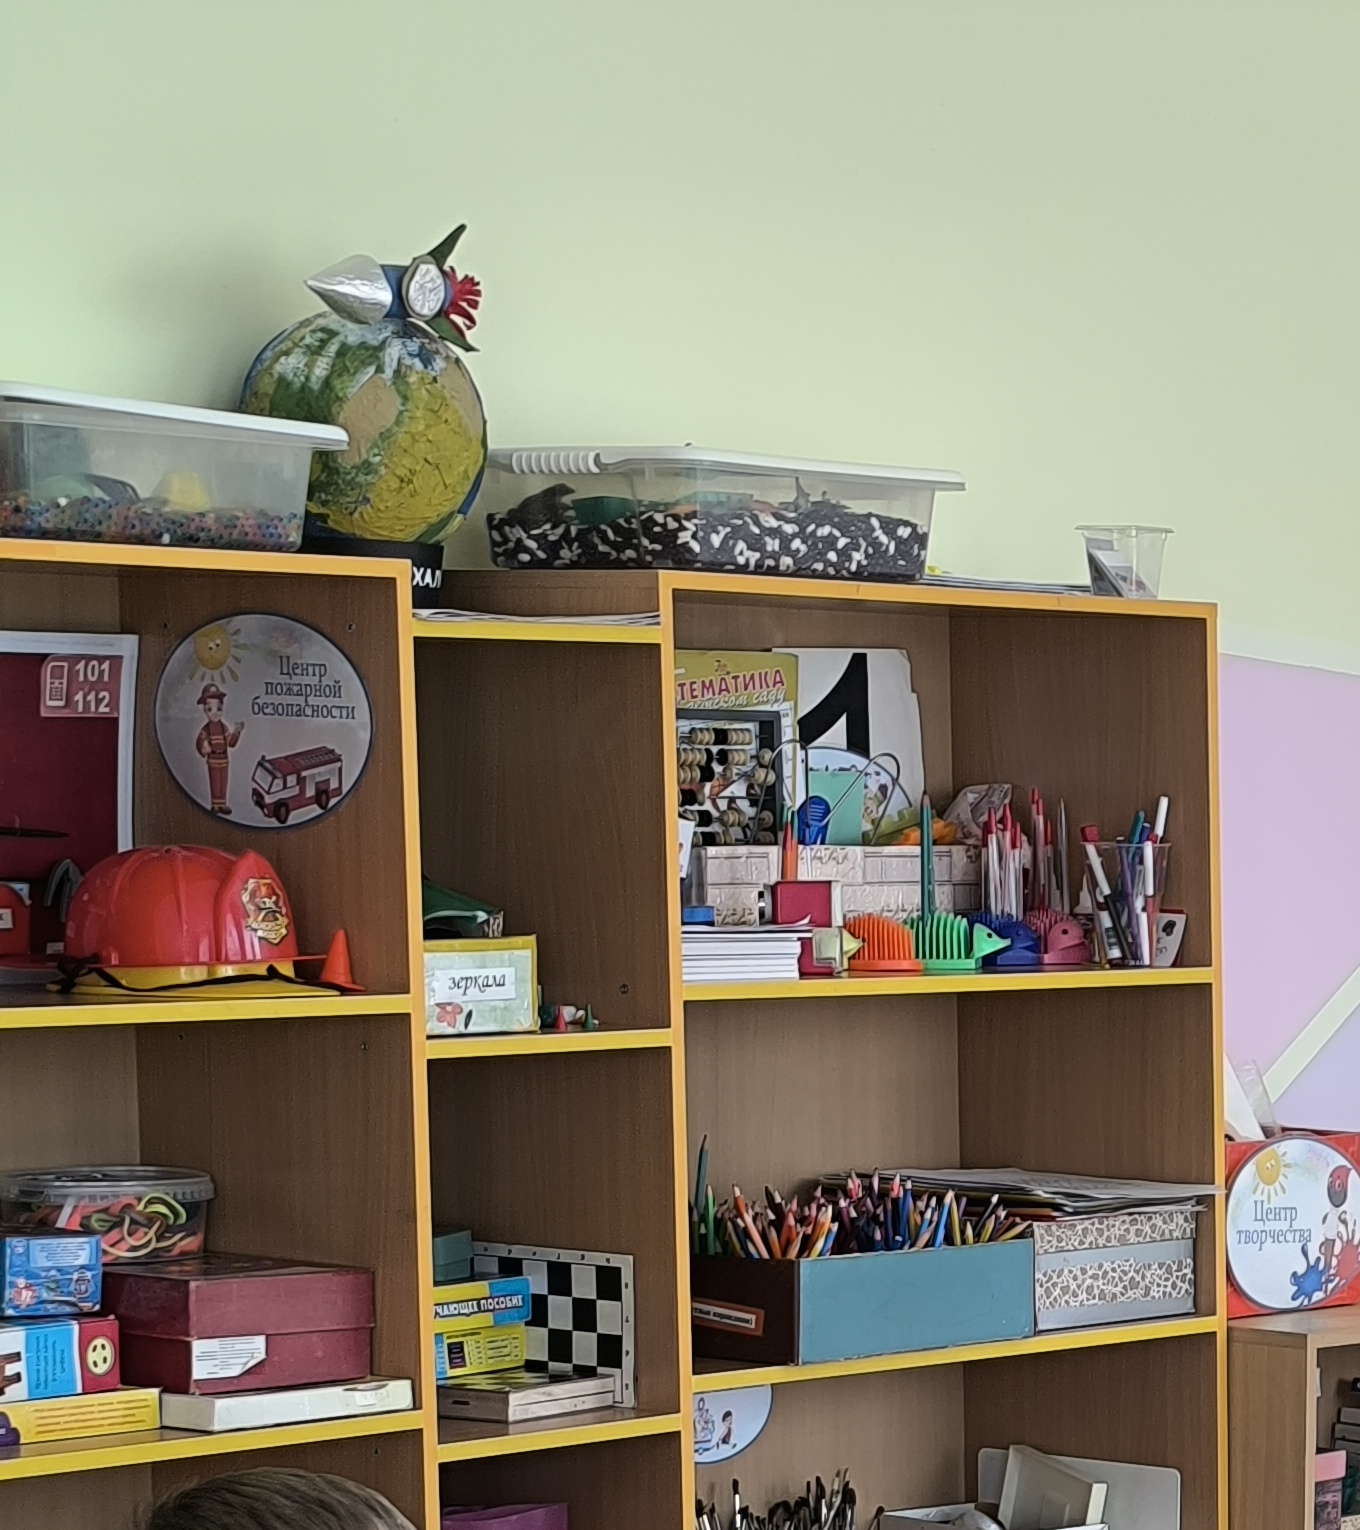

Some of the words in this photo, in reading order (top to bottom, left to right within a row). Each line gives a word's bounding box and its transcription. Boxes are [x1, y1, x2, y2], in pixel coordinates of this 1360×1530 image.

[75, 660, 111, 682] 101
[279, 655, 328, 683] Центр
[73, 690, 111, 714] 112
[264, 680, 343, 704] пожарной
[251, 695, 357, 720] безопасности
[447, 973, 507, 997] зеркала
[1253, 1199, 1298, 1229] Центр
[1236, 1228, 1312, 1252] творчества
[433, 1300, 479, 1319] ЧАЮЩЕЕ
[480, 1294, 524, 1312] ПОСОБИЕ
